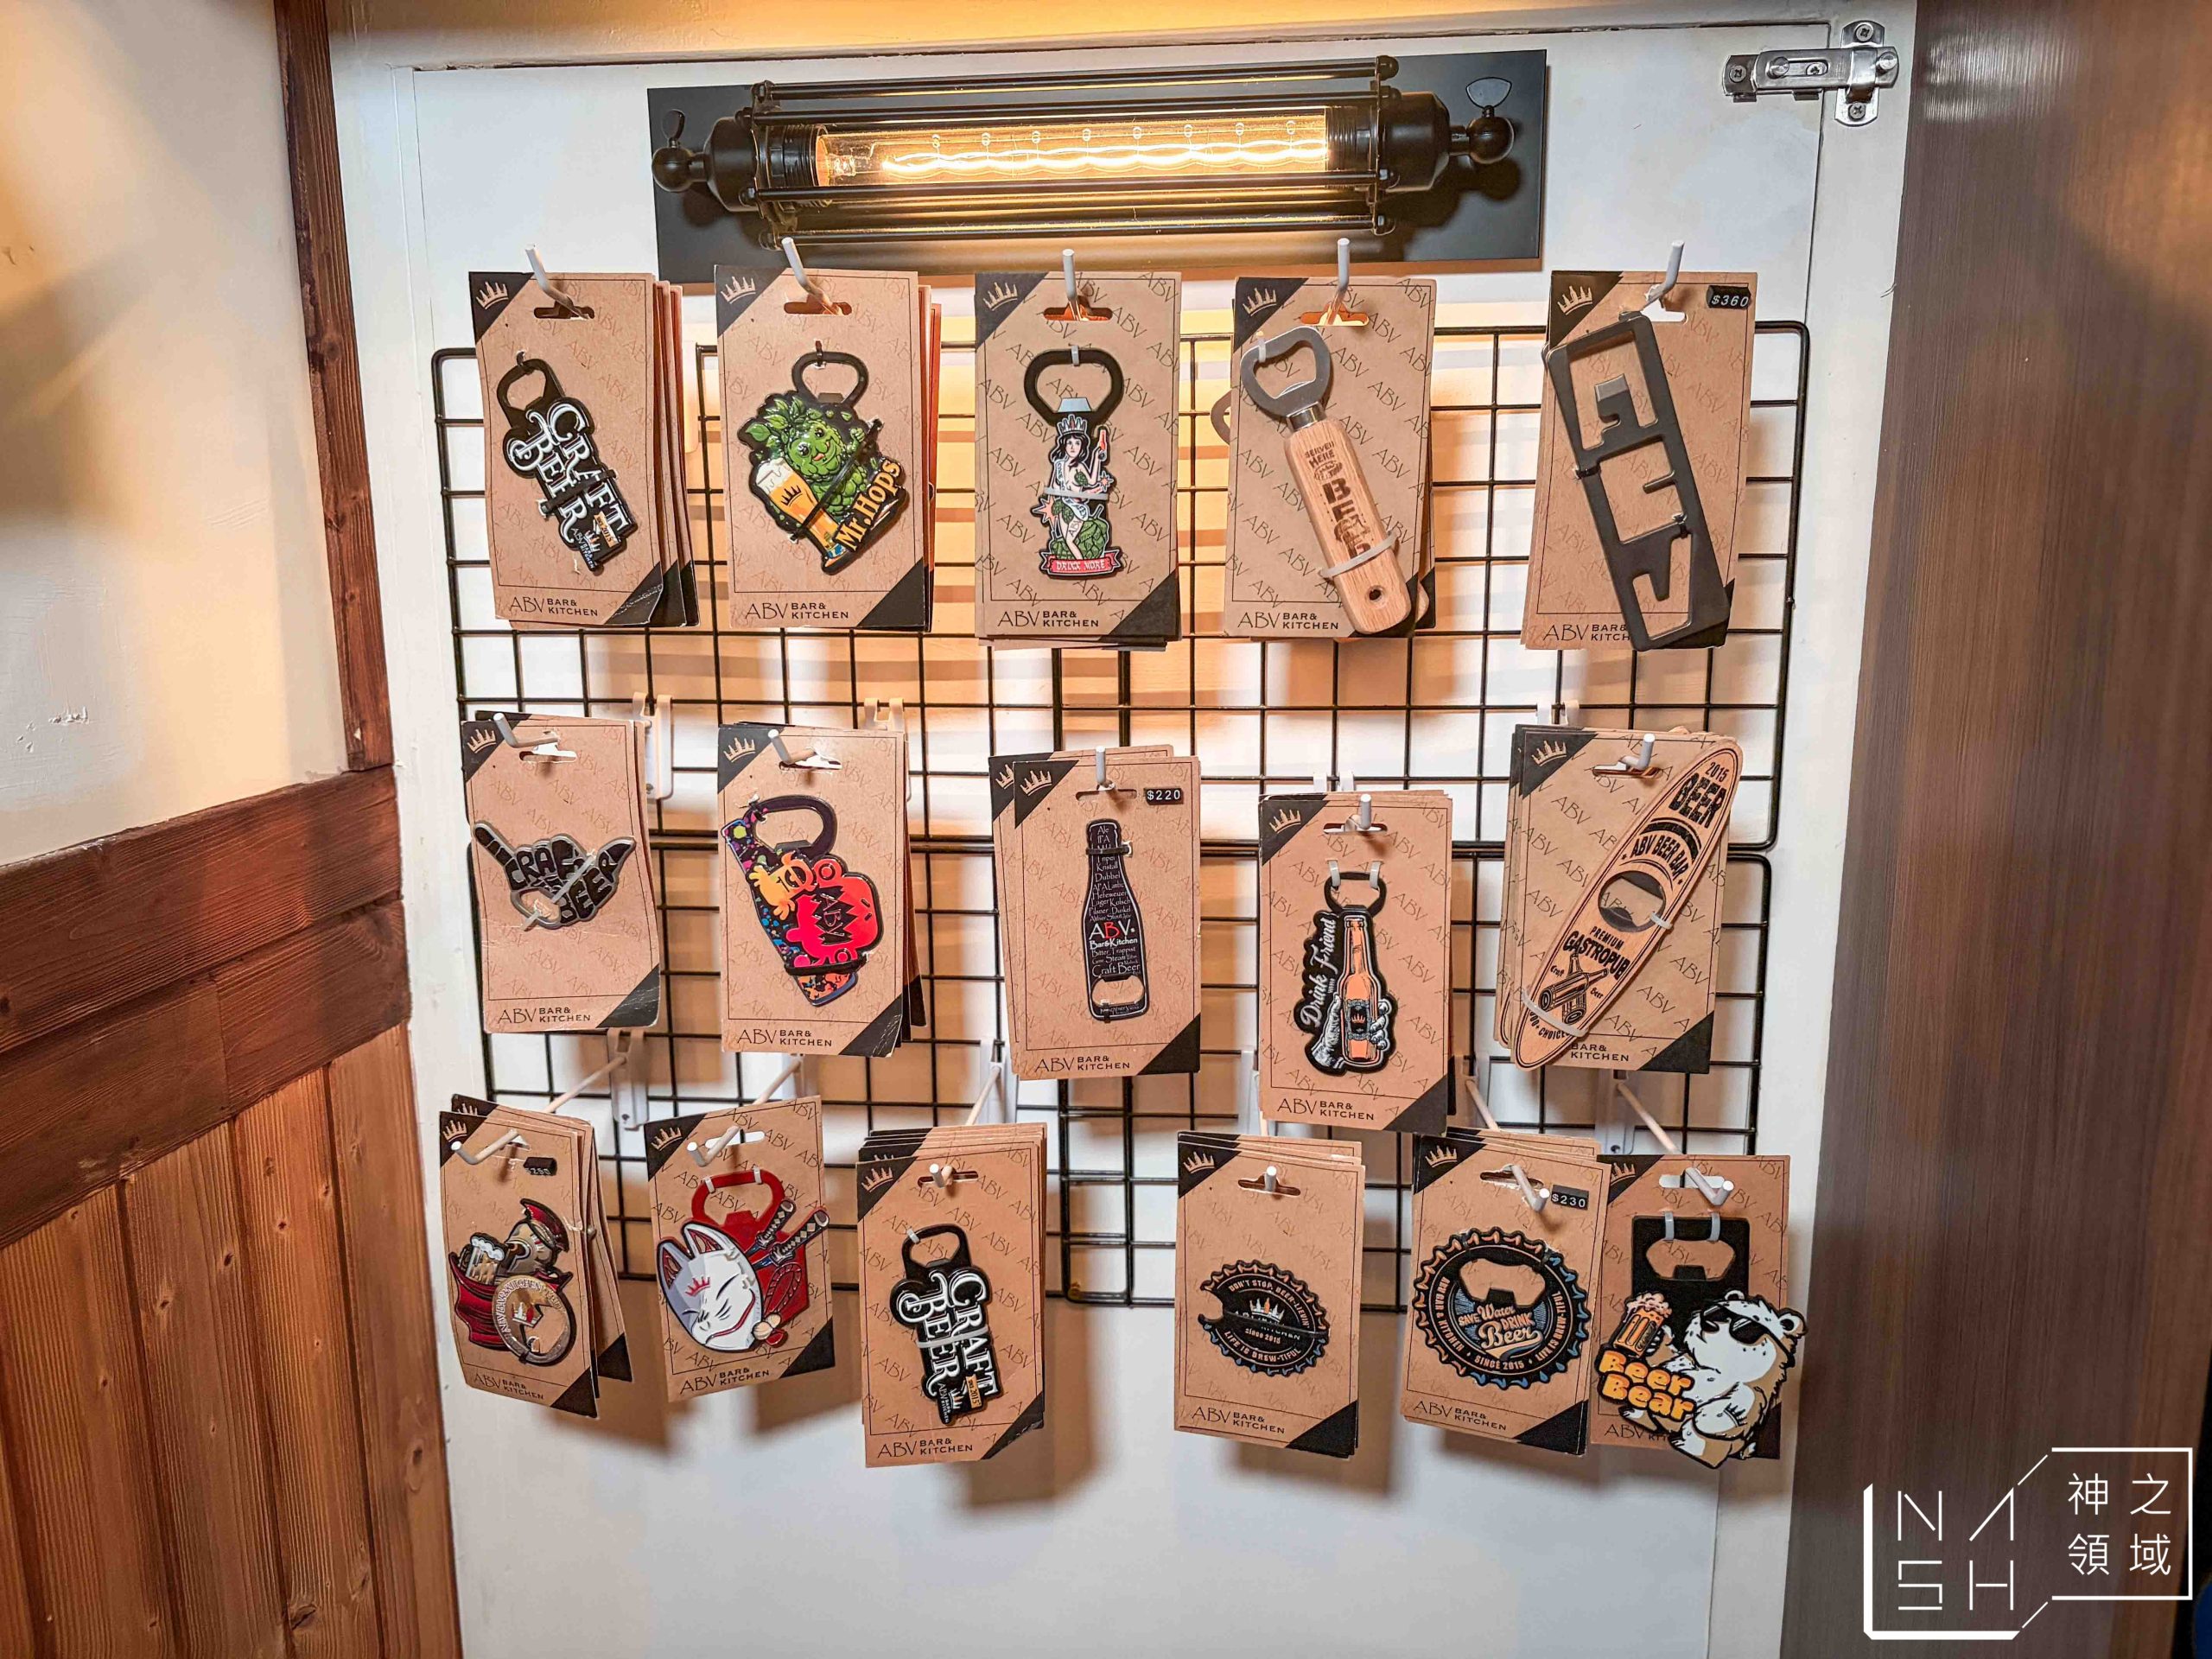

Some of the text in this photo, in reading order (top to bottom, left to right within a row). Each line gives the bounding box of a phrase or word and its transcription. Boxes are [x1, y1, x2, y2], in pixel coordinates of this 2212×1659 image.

[1712, 294, 1749, 308] $360
[547, 401, 629, 531] CRAFT
[507, 410, 588, 543] BEER
[509, 596, 545, 613] ABV
[547, 598, 577, 607] BAR&
[548, 607, 599, 617] KITCHEN
[746, 602, 788, 620] ABV
[791, 611, 849, 620] KITCHEN
[998, 611, 1039, 627] ABV
[1042, 619, 1099, 627] KITCHEN
[1238, 611, 1281, 629] ABV
[1282, 621, 1338, 631] KITCHEN
[1543, 625, 1589, 641] ABV
[1591, 633, 1630, 642] KITCH
[1706, 761, 1729, 783] 2015
[1147, 789, 1181, 801] $220
[1669, 772, 1727, 829] BEER
[1630, 834, 1689, 881] ABV BEER BAR
[1095, 871, 1121, 882] Dubbel
[821, 892, 845, 944] ABV
[1589, 925, 1624, 950] PREMIUM
[1310, 917, 1338, 975] Friend
[1562, 931, 1630, 981] GASTROPUB
[1092, 962, 1141, 977] Craft Beer
[1300, 974, 1328, 1027] Drink
[498, 1008, 537, 1025] ABV
[539, 1014, 591, 1023] KITCHEN
[737, 1029, 777, 1045] ABV
[779, 1038, 833, 1047] KITCHEN
[1036, 1057, 1074, 1072] ABV
[1571, 1052, 1629, 1061] KITCHEN
[1077, 1062, 1130, 1071] KITCHEN
[1278, 1098, 1317, 1116] ABV
[1319, 1101, 1353, 1109] BAR&
[1319, 1110, 1375, 1121] KITCHEN
[1552, 1192, 1586, 1208] $230
[1459, 1303, 1516, 1326] SAVE Water
[1500, 1312, 1535, 1331] DRINK
[896, 1270, 961, 1396] BEER
[949, 1269, 998, 1395] CRAFT
[1224, 1331, 1241, 1348] LIFE
[1478, 1320, 1543, 1349] Beer
[1535, 1346, 1554, 1362] LIFE
[1474, 1355, 1525, 1370] SINCE 2015
[473, 1372, 502, 1389] ABV
[719, 1367, 750, 1378] BAR&
[720, 1370, 770, 1386] KITCHEN
[1599, 1350, 1694, 1395] Beer
[680, 1373, 717, 1395] ABV
[503, 1387, 544, 1400] KITCHEN
[1601, 1373, 1695, 1421] Bear
[1191, 1408, 1231, 1424] ABV
[1233, 1412, 1265, 1422] BAR&
[1413, 1401, 1452, 1418] ABV
[1454, 1408, 1487, 1420] BAR&
[1233, 1420, 1285, 1433] KITCHEN
[1454, 1414, 1506, 1431] KITCHEN
[877, 1440, 917, 1459] ABV
[919, 1438, 952, 1446] BAR&
[920, 1444, 973, 1455] KITCHEN
